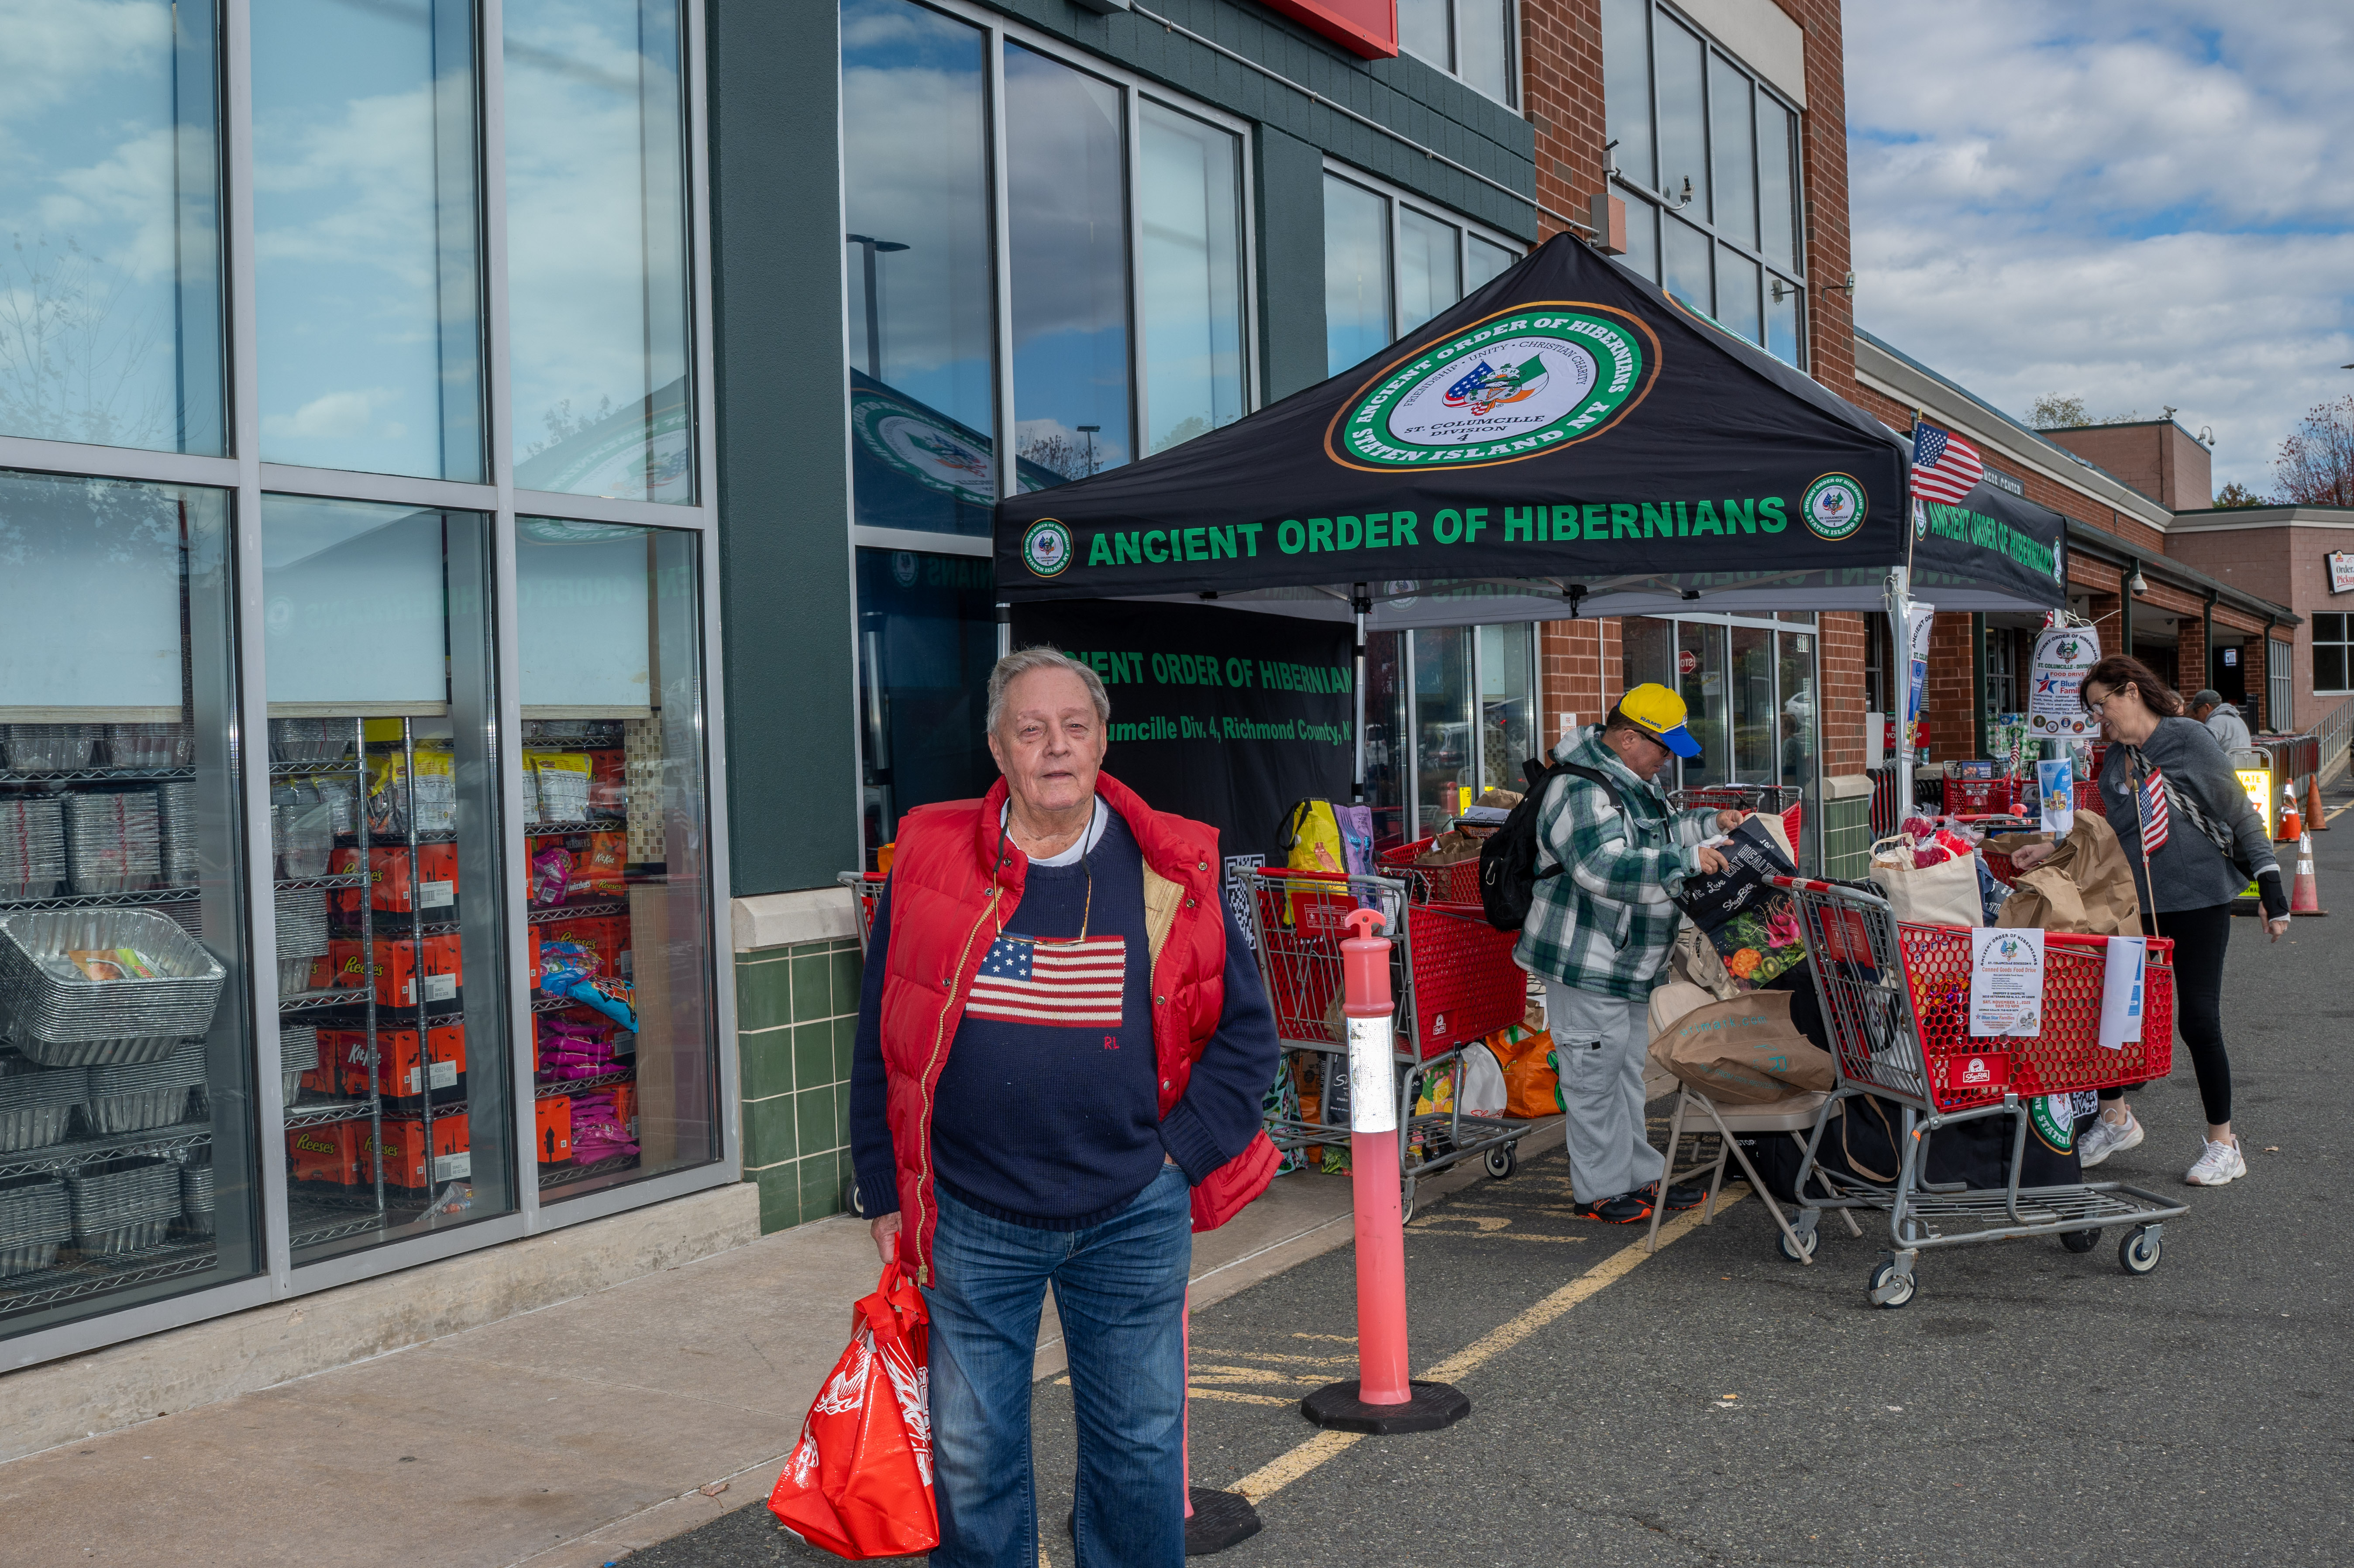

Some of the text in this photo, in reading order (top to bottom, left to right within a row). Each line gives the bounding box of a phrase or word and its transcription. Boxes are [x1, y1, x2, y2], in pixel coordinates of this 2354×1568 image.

[1359, 317, 1629, 423] ANCIENT ORDER OF HIBERNIANS
[1403, 341, 1587, 407] FRIENDSHIP UNITY CHRISTIAN CHARITY
[1353, 401, 1611, 461] STATEN ISLAND NY
[1404, 415, 1545, 433] ST. COLUMCILLE
[1429, 426, 1508, 437] DIVISION
[1805, 489, 1816, 512] ANCIENT
[1816, 478, 1834, 489] ORDER
[1844, 480, 1863, 509] HIBERNIANS
[2001, 478, 2021, 495] CENTER
[1088, 523, 1263, 566] ANCIENT
[1277, 510, 1418, 553] ORDER
[1433, 507, 1488, 544] OF
[1504, 496, 1787, 542] HIBERNIANS
[1807, 512, 1861, 535] STATEN ISLAND NY
[1026, 532, 1034, 553] ANCIENT
[1033, 523, 1048, 533] ORDER
[1055, 525, 1070, 550] HIBERNIANS
[1928, 501, 1970, 543] ANCIENT
[1970, 511, 1998, 551] ORDER
[1998, 522, 2009, 555] OF
[2009, 528, 2054, 577] HIBERNIANS
[1026, 552, 1069, 572] STATEN ISLAND NY
[1912, 613, 1934, 649] ANCIENT ORD
[1797, 634, 1808, 652] 3010
[2037, 639, 2051, 660] ANCIENT
[2079, 635, 2098, 660] HIBERNIANS
[1152, 653, 1223, 686] ORDER
[1226, 657, 1253, 688] OF
[1106, 716, 1342, 746] umcille Div. 4, Richmond County,
[1640, 716, 1662, 729] RAMS
[566, 838, 591, 849] HERSHEY'S
[1707, 879, 1726, 893] Love
[1737, 844, 1784, 877] HEALTHY
[568, 880, 591, 892] wizzlers
[599, 880, 622, 890] Reese's
[1723, 883, 1754, 911] ShopRite
[560, 932, 597, 950] Reese's
[1980, 942, 1992, 966] ANCIENT
[1992, 933, 2008, 943] ORDER
[2017, 935, 2037, 966] HIBERNIANS
[1679, 1016, 1768, 1038] primark.com
[1104, 1036, 1120, 1049] RL
[1714, 1068, 1734, 1080] FROM
[1734, 1076, 1747, 1084] 100%
[1965, 1072, 1989, 1082] ShopRite
[2037, 1114, 2066, 1145] STATEN
[296, 1134, 335, 1156] Reese's
